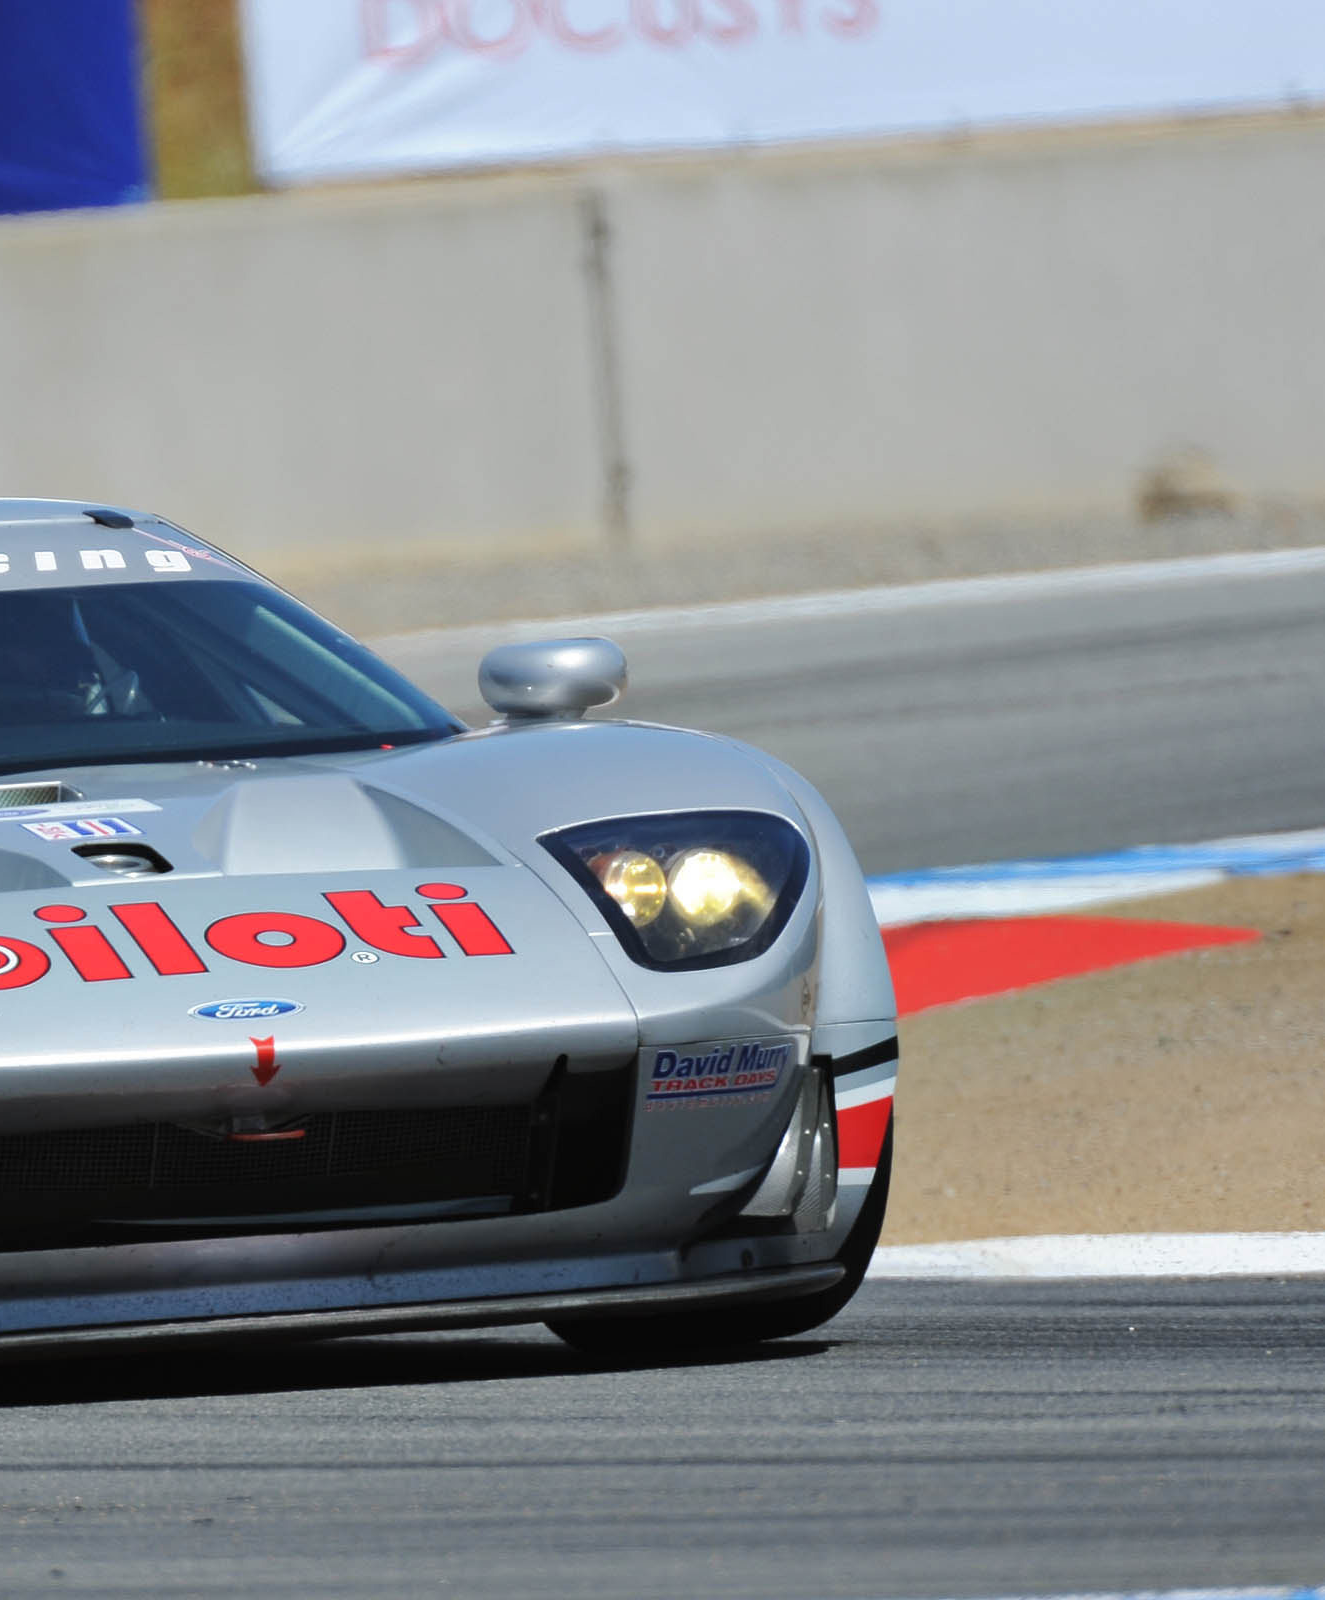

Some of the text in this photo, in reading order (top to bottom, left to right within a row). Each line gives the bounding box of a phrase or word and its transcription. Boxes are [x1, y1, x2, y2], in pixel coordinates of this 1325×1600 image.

[652, 1042, 793, 1080] David Murry
[650, 1068, 777, 1092] TRACK DAYS
